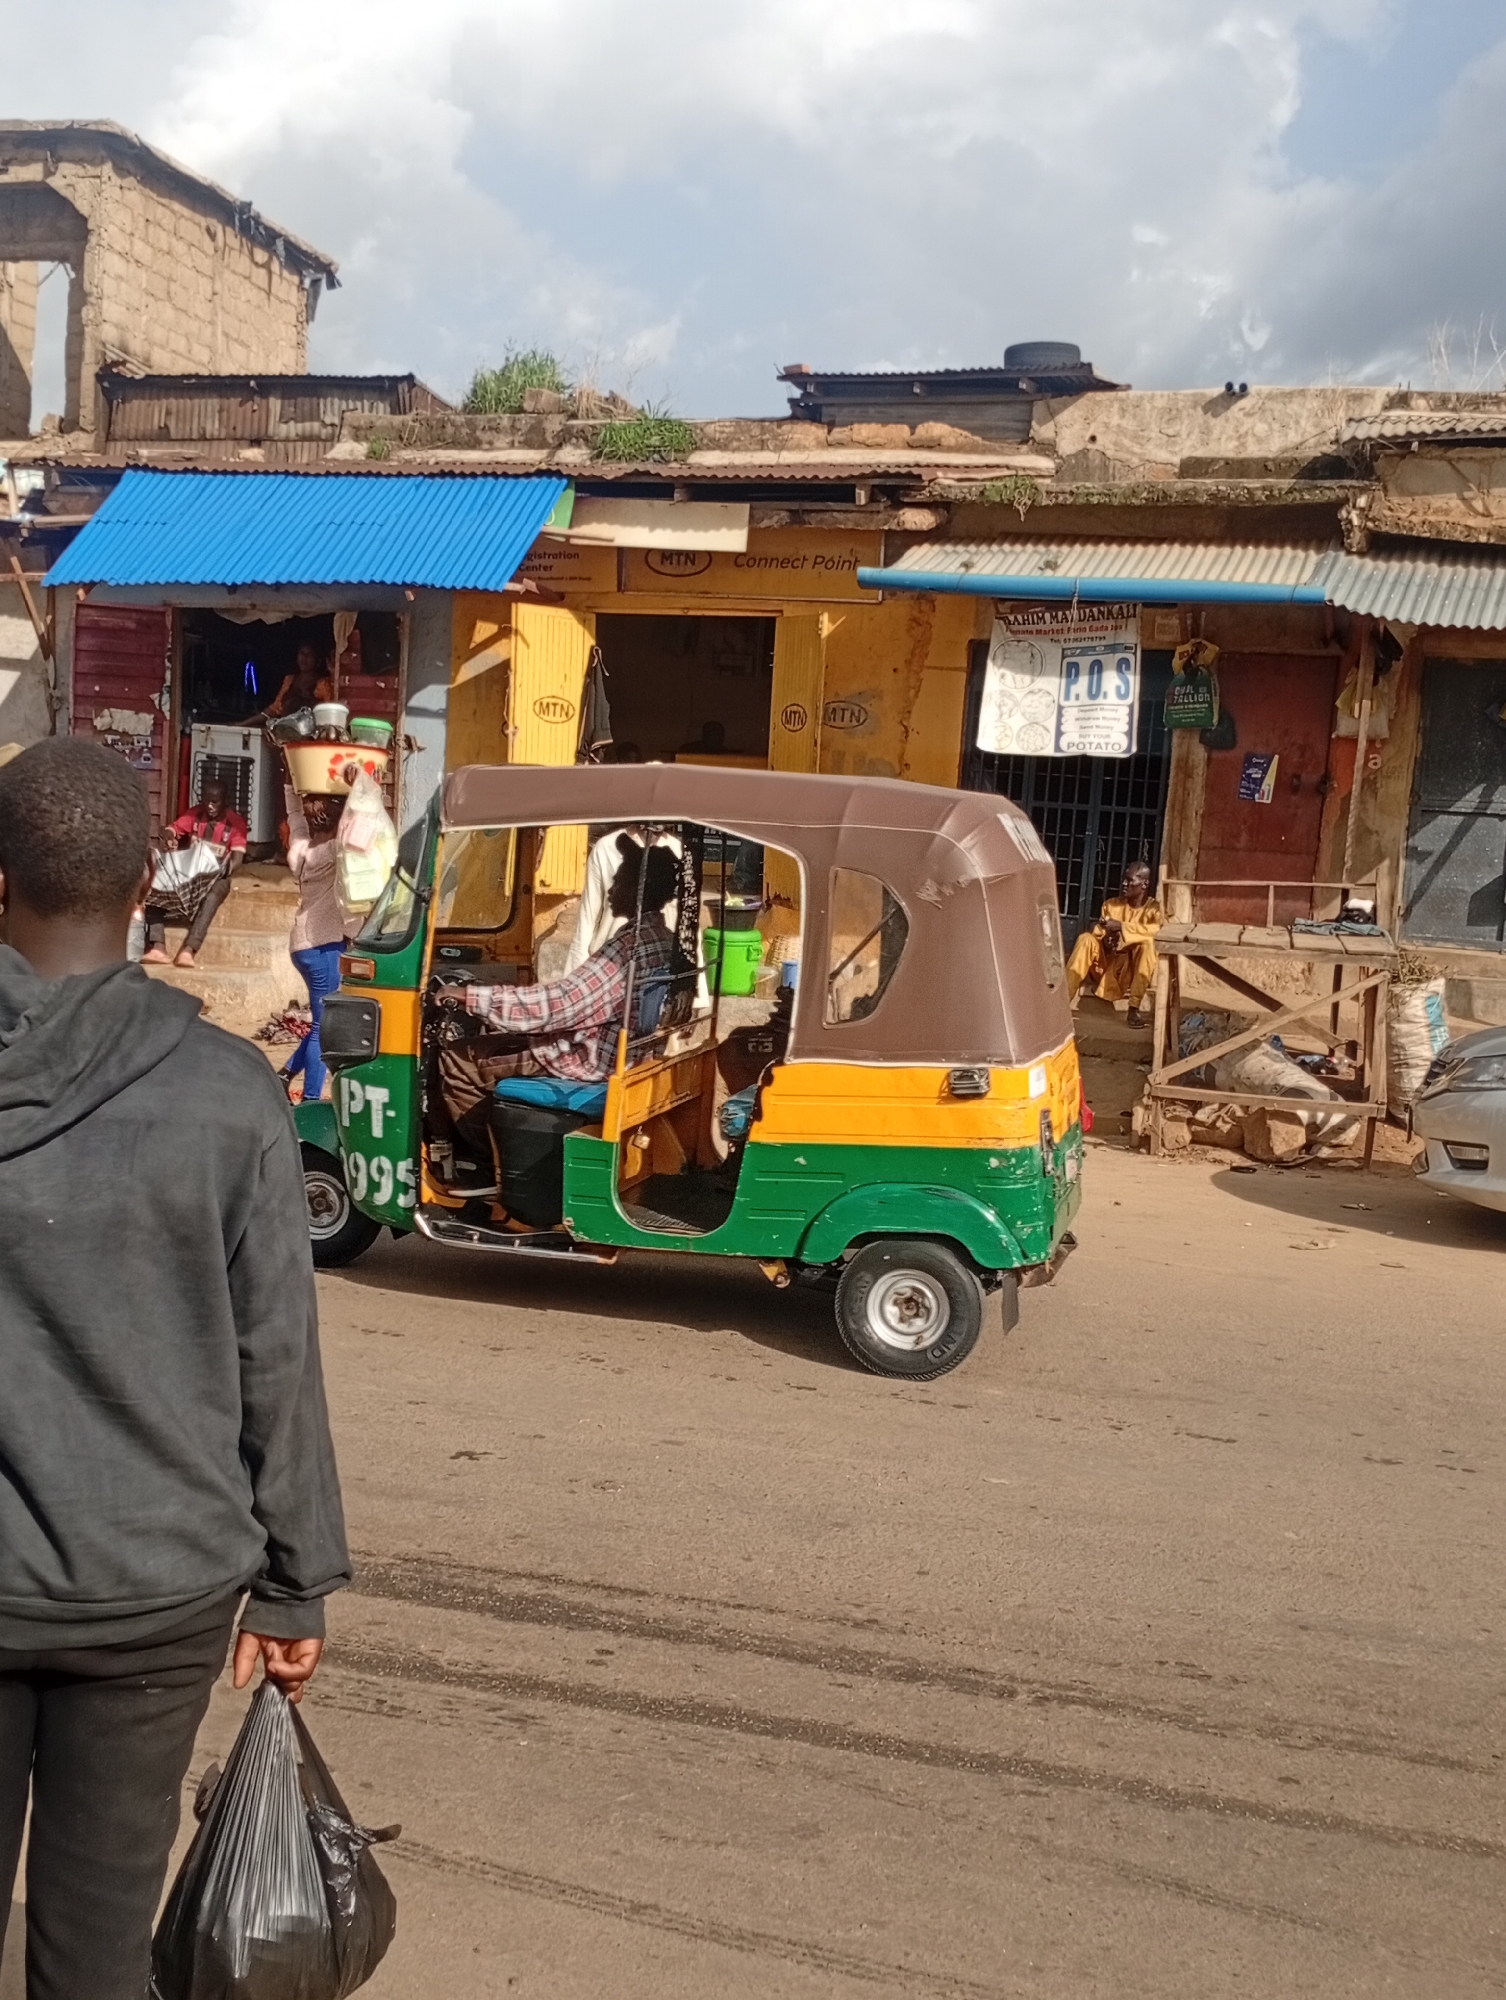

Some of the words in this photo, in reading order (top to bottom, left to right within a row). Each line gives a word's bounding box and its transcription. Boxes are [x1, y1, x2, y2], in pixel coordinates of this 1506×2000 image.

[527, 550, 580, 562] gistration
[660, 551, 696, 567] MTN
[733, 553, 808, 569] Connect
[812, 554, 861, 571] Point
[1077, 603, 1137, 623] DANKALI
[1172, 693, 1211, 704] TALLION
[539, 700, 570, 719] MTN
[1099, 706, 1119, 714] Money
[784, 709, 804, 727] MTN
[1066, 741, 1122, 752] POTATO
